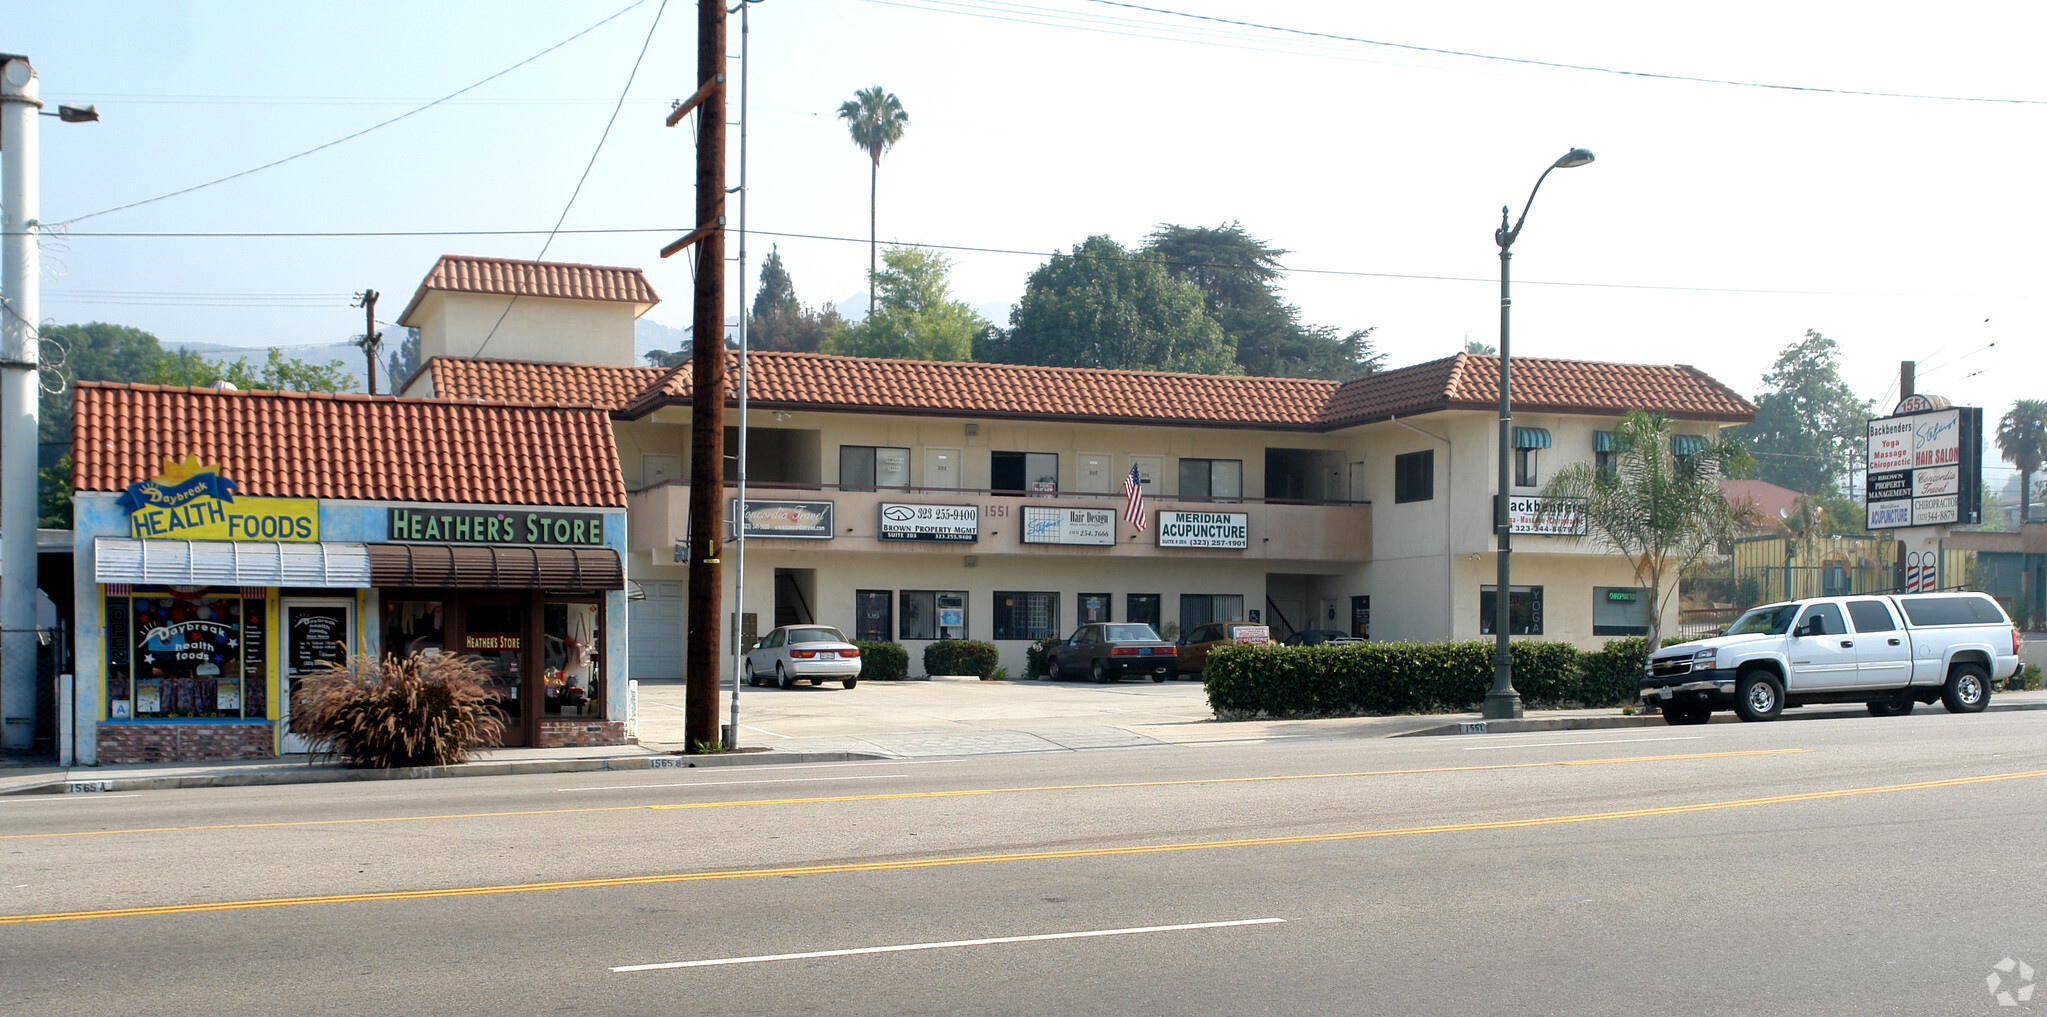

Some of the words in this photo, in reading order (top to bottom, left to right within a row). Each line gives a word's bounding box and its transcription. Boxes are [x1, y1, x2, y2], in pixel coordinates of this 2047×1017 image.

[1901, 398, 1926, 411] 1551
[1870, 423, 1912, 436] Backbenders
[1882, 440, 1900, 448] Yoga
[1874, 450, 1907, 459] Massage
[1916, 450, 1933, 466] HAIR
[1935, 447, 1959, 464] SALON
[1870, 458, 1910, 469] Chiropractic
[1878, 473, 1903, 481] BROWN
[1917, 470, 1955, 484] Concordia
[1875, 480, 1906, 490] PROPERTY
[1921, 481, 1949, 494] Travel
[145, 482, 208, 505] Daybreak
[1868, 488, 1912, 499] MANAGEMENT
[1510, 500, 1585, 513] ackbenders
[1914, 497, 1958, 510] CHIROPRACTOR
[792, 505, 829, 520] Travel
[918, 508, 932, 519] 323
[935, 508, 976, 521] 255-9400
[985, 505, 1009, 517] 1551
[1871, 508, 1908, 525] ACUPUNCTURE
[1928, 510, 1954, 521] 344-8879
[133, 501, 225, 538] HEALTH
[1070, 511, 1084, 523] Hair
[1087, 511, 1108, 525] Design
[1176, 513, 1231, 524] MERIDIAN
[228, 515, 312, 538] FOODS
[393, 509, 514, 542] HEATHER'S
[527, 513, 600, 543] STORE
[915, 525, 951, 533] PROPERTY
[1162, 524, 1245, 538] ACUPUNCTURE
[1532, 590, 1541, 633] YOGA
[157, 623, 225, 640] Daybreak
[175, 641, 215, 652] health
[176, 651, 209, 661] foods
[117, 705, 125, 714] A
[1466, 723, 1483, 733] 1551
[651, 759, 673, 768] 1565
[69, 782, 97, 793] 1565
[100, 782, 106, 791] A
